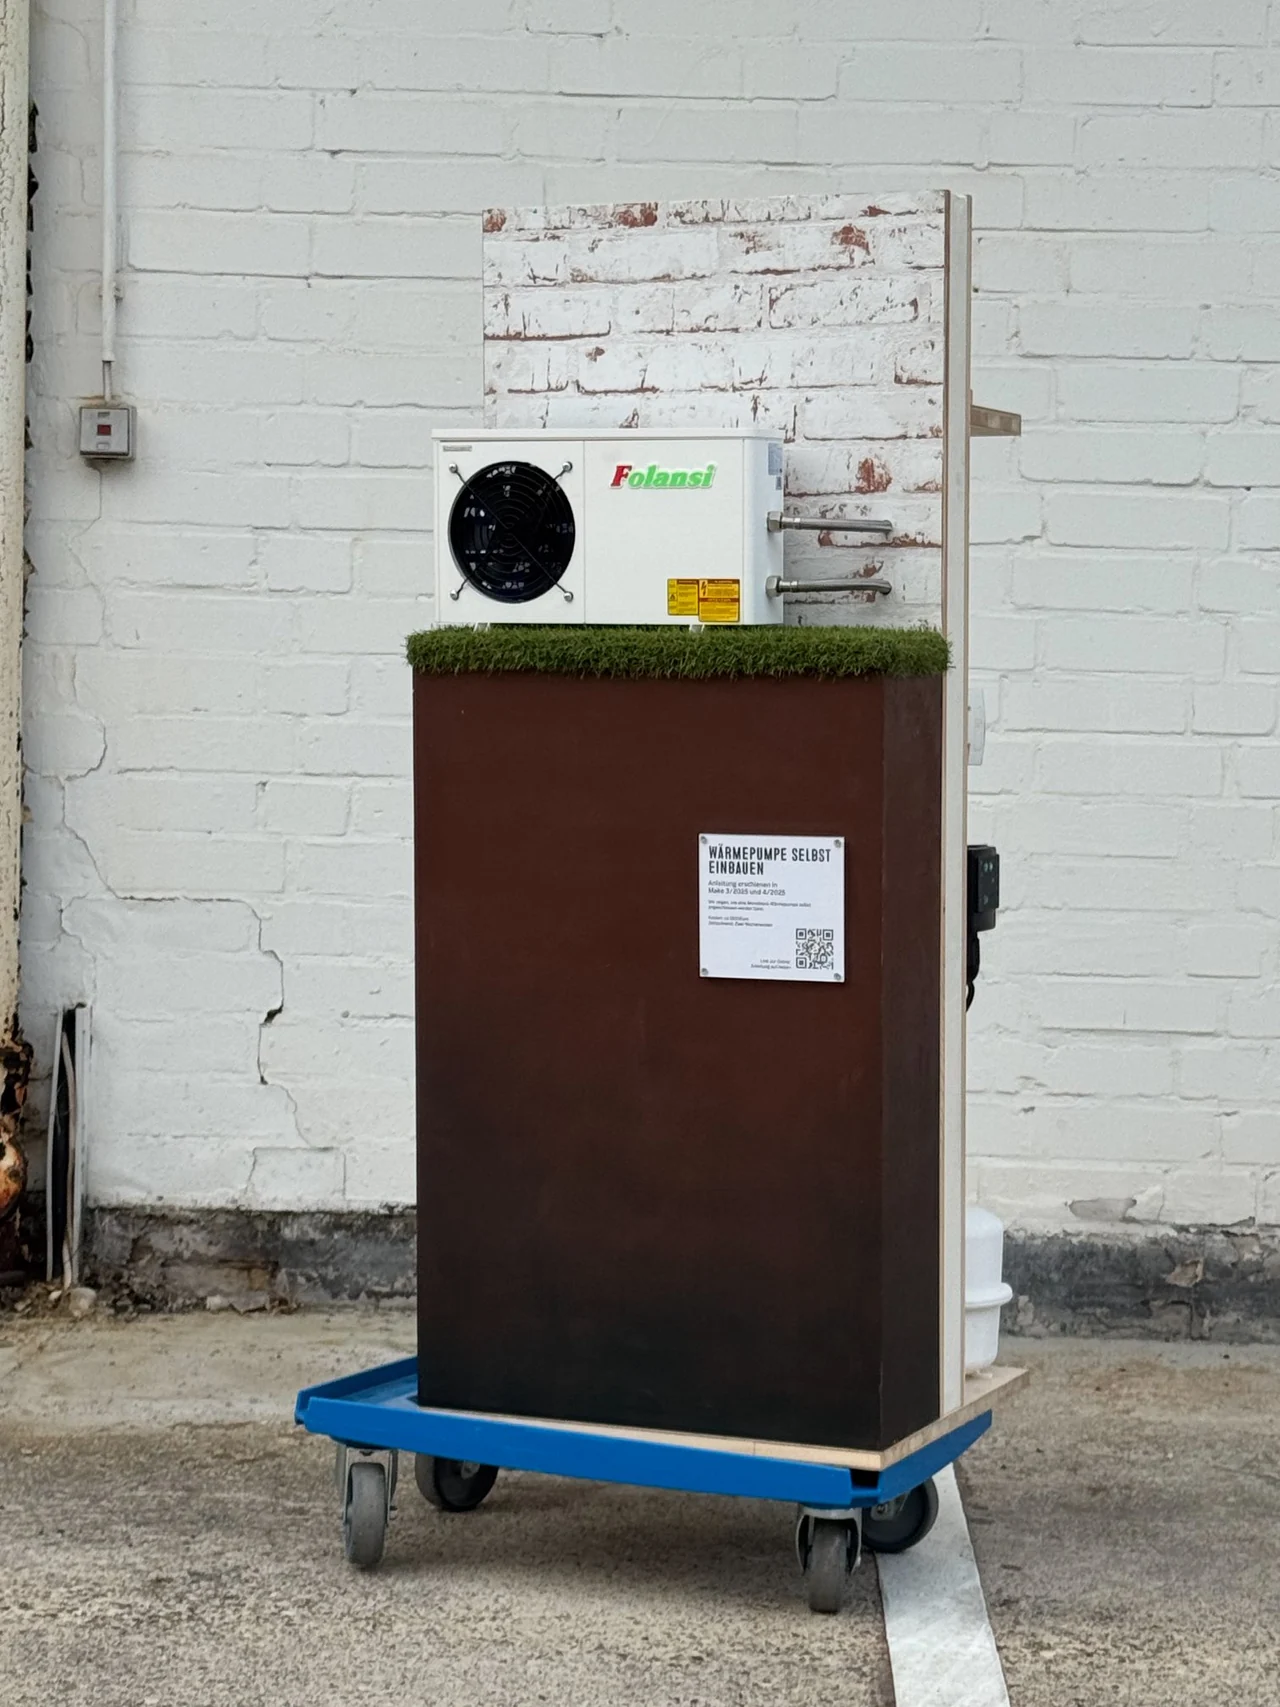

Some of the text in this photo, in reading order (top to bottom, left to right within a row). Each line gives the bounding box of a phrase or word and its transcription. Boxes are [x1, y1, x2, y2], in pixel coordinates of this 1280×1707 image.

[610, 464, 716, 488] Folansi
[708, 843, 831, 862] WÄRMEPUMPE SELBST
[708, 860, 764, 875] EINBAUEN
